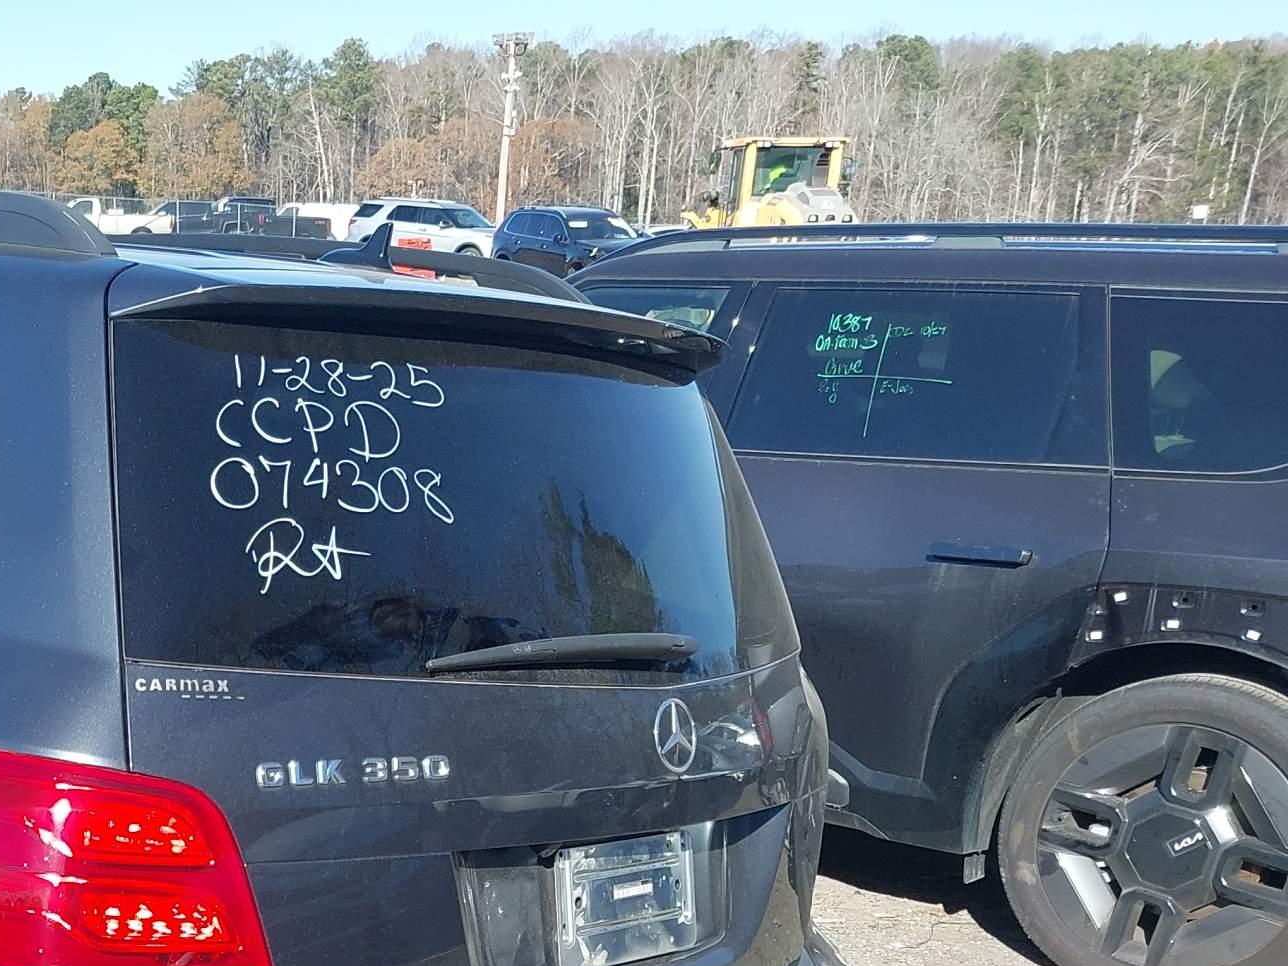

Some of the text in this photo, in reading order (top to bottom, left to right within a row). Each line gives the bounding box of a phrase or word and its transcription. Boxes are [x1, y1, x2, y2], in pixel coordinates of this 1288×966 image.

[234, 354, 445, 407] 11-28-25
[215, 397, 401, 463] CCPD
[210, 454, 454, 524] 074308
[255, 754, 451, 789] GLK 350
